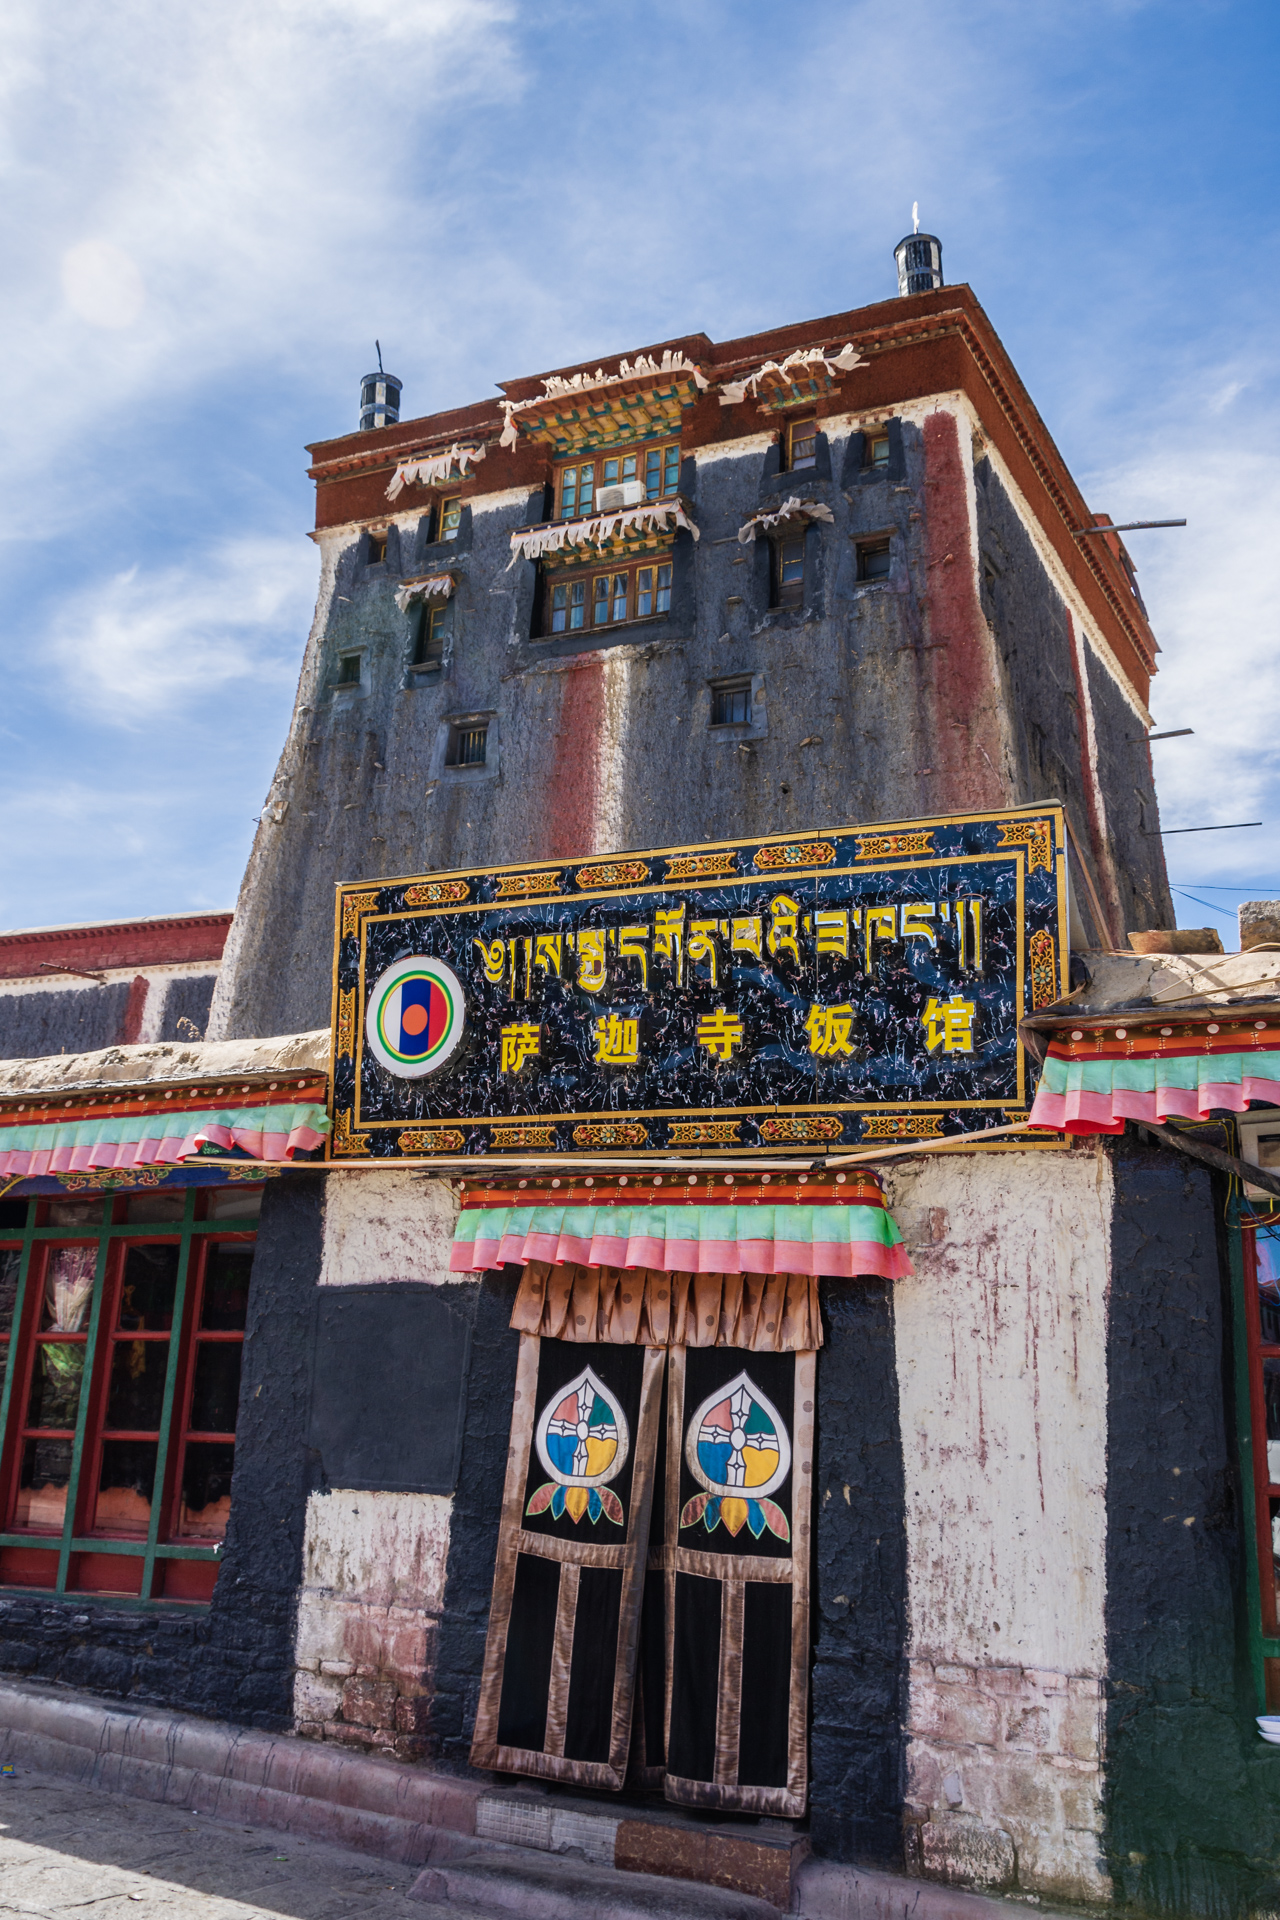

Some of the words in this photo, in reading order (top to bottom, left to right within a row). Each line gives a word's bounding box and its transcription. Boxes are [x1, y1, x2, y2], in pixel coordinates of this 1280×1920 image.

[500, 995, 976, 1073] 萨迦寺饭馆
